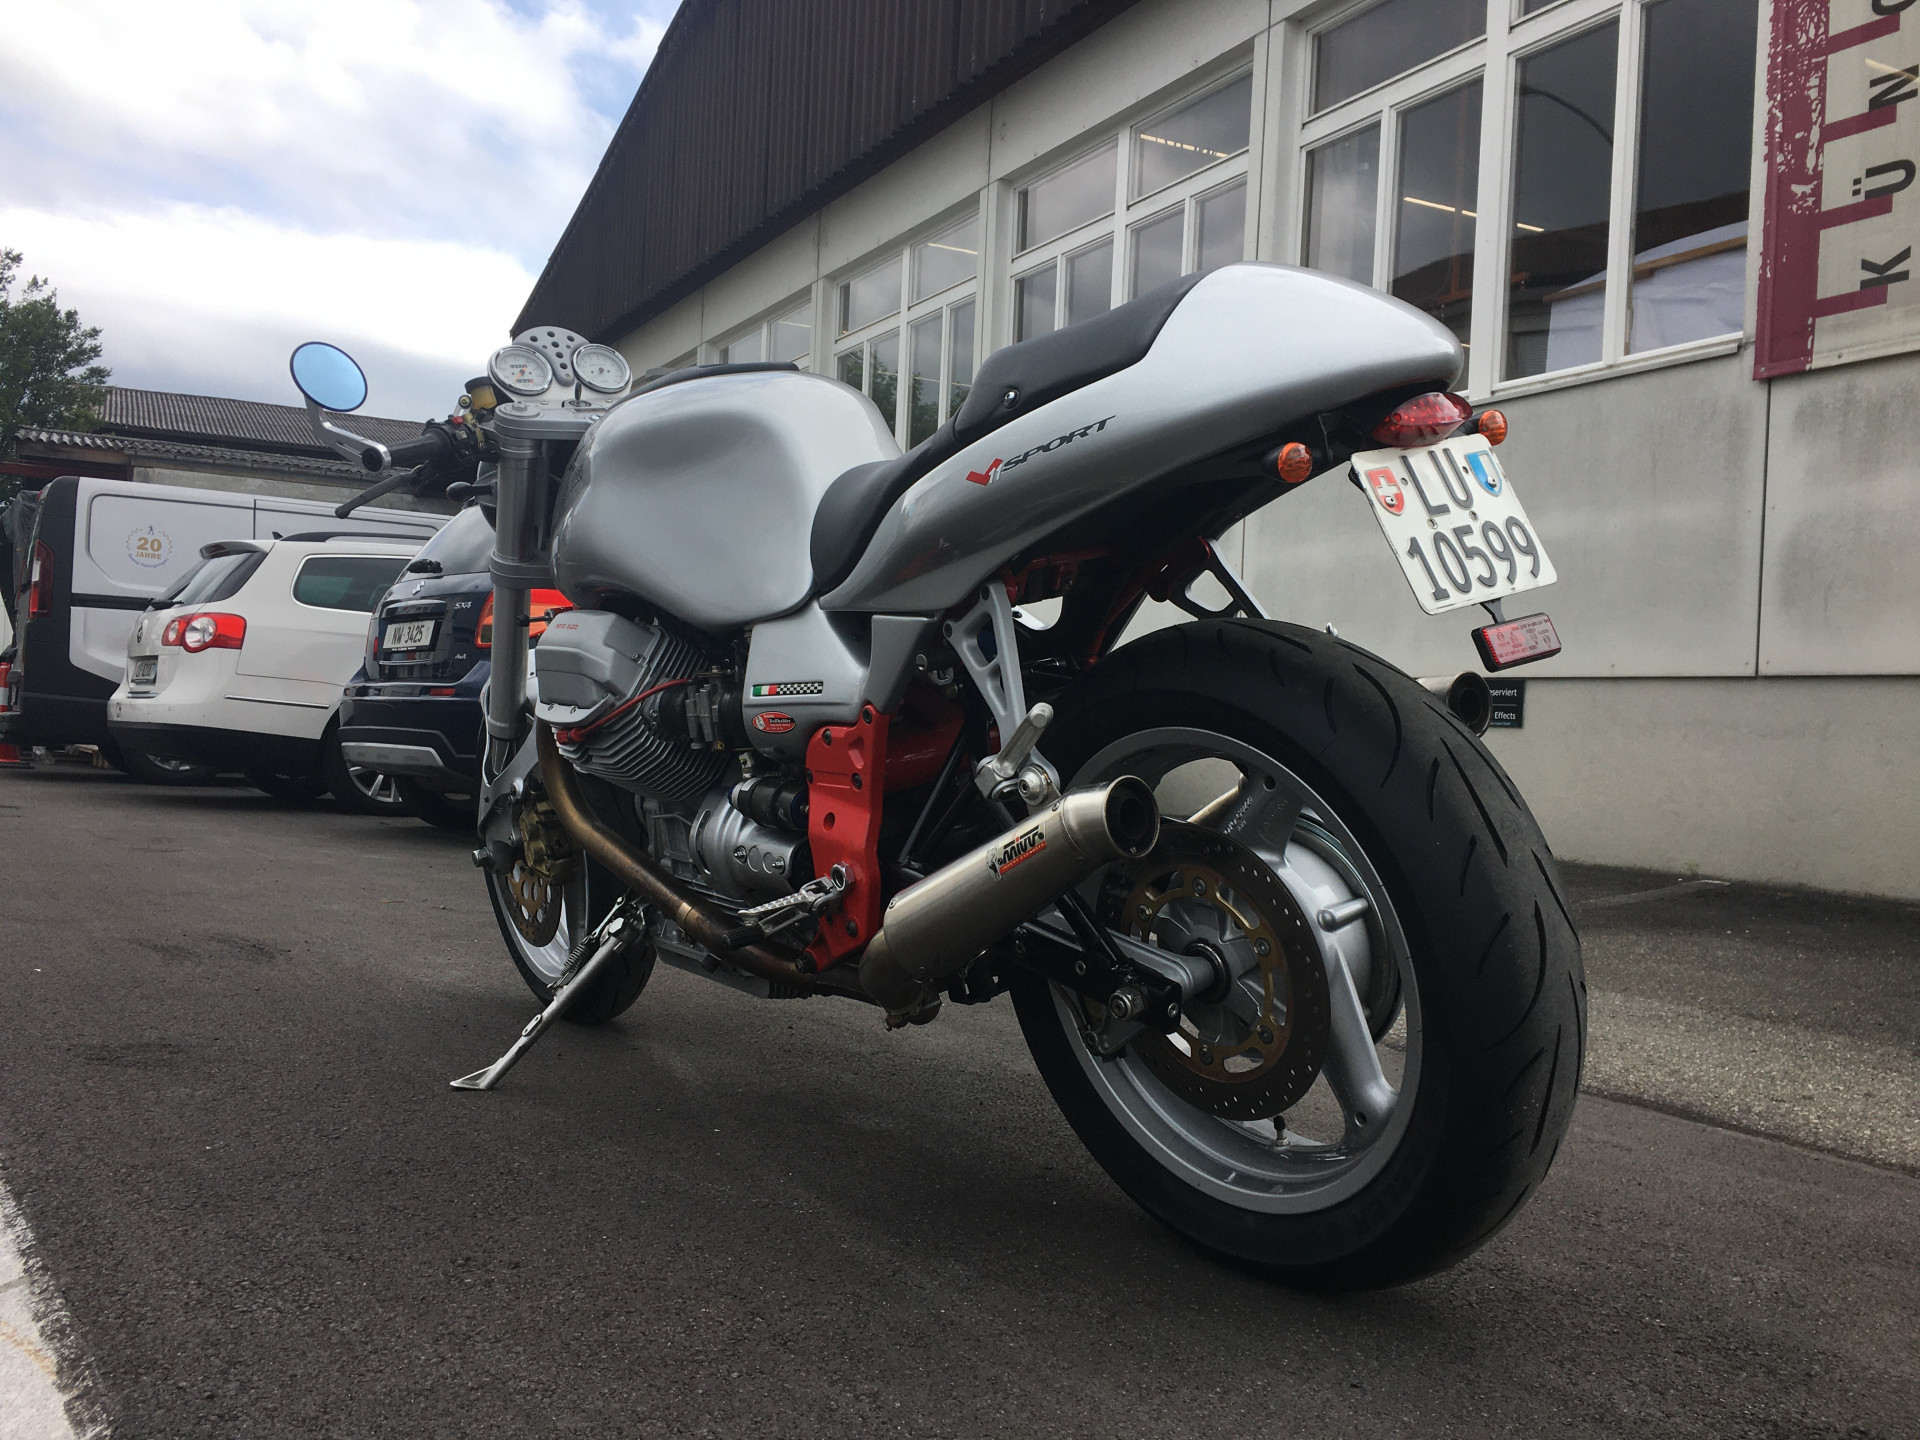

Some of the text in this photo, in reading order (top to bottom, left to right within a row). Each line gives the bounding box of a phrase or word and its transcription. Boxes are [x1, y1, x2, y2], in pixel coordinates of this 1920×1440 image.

[1001, 415, 1116, 472] SPORT
[1400, 447, 1474, 516] LU
[136, 536, 162, 552] 20
[135, 551, 162, 561] JAHRE
[1407, 516, 1541, 601] 10599
[453, 601, 472, 609] SX4
[1494, 711, 1517, 720] Effects
